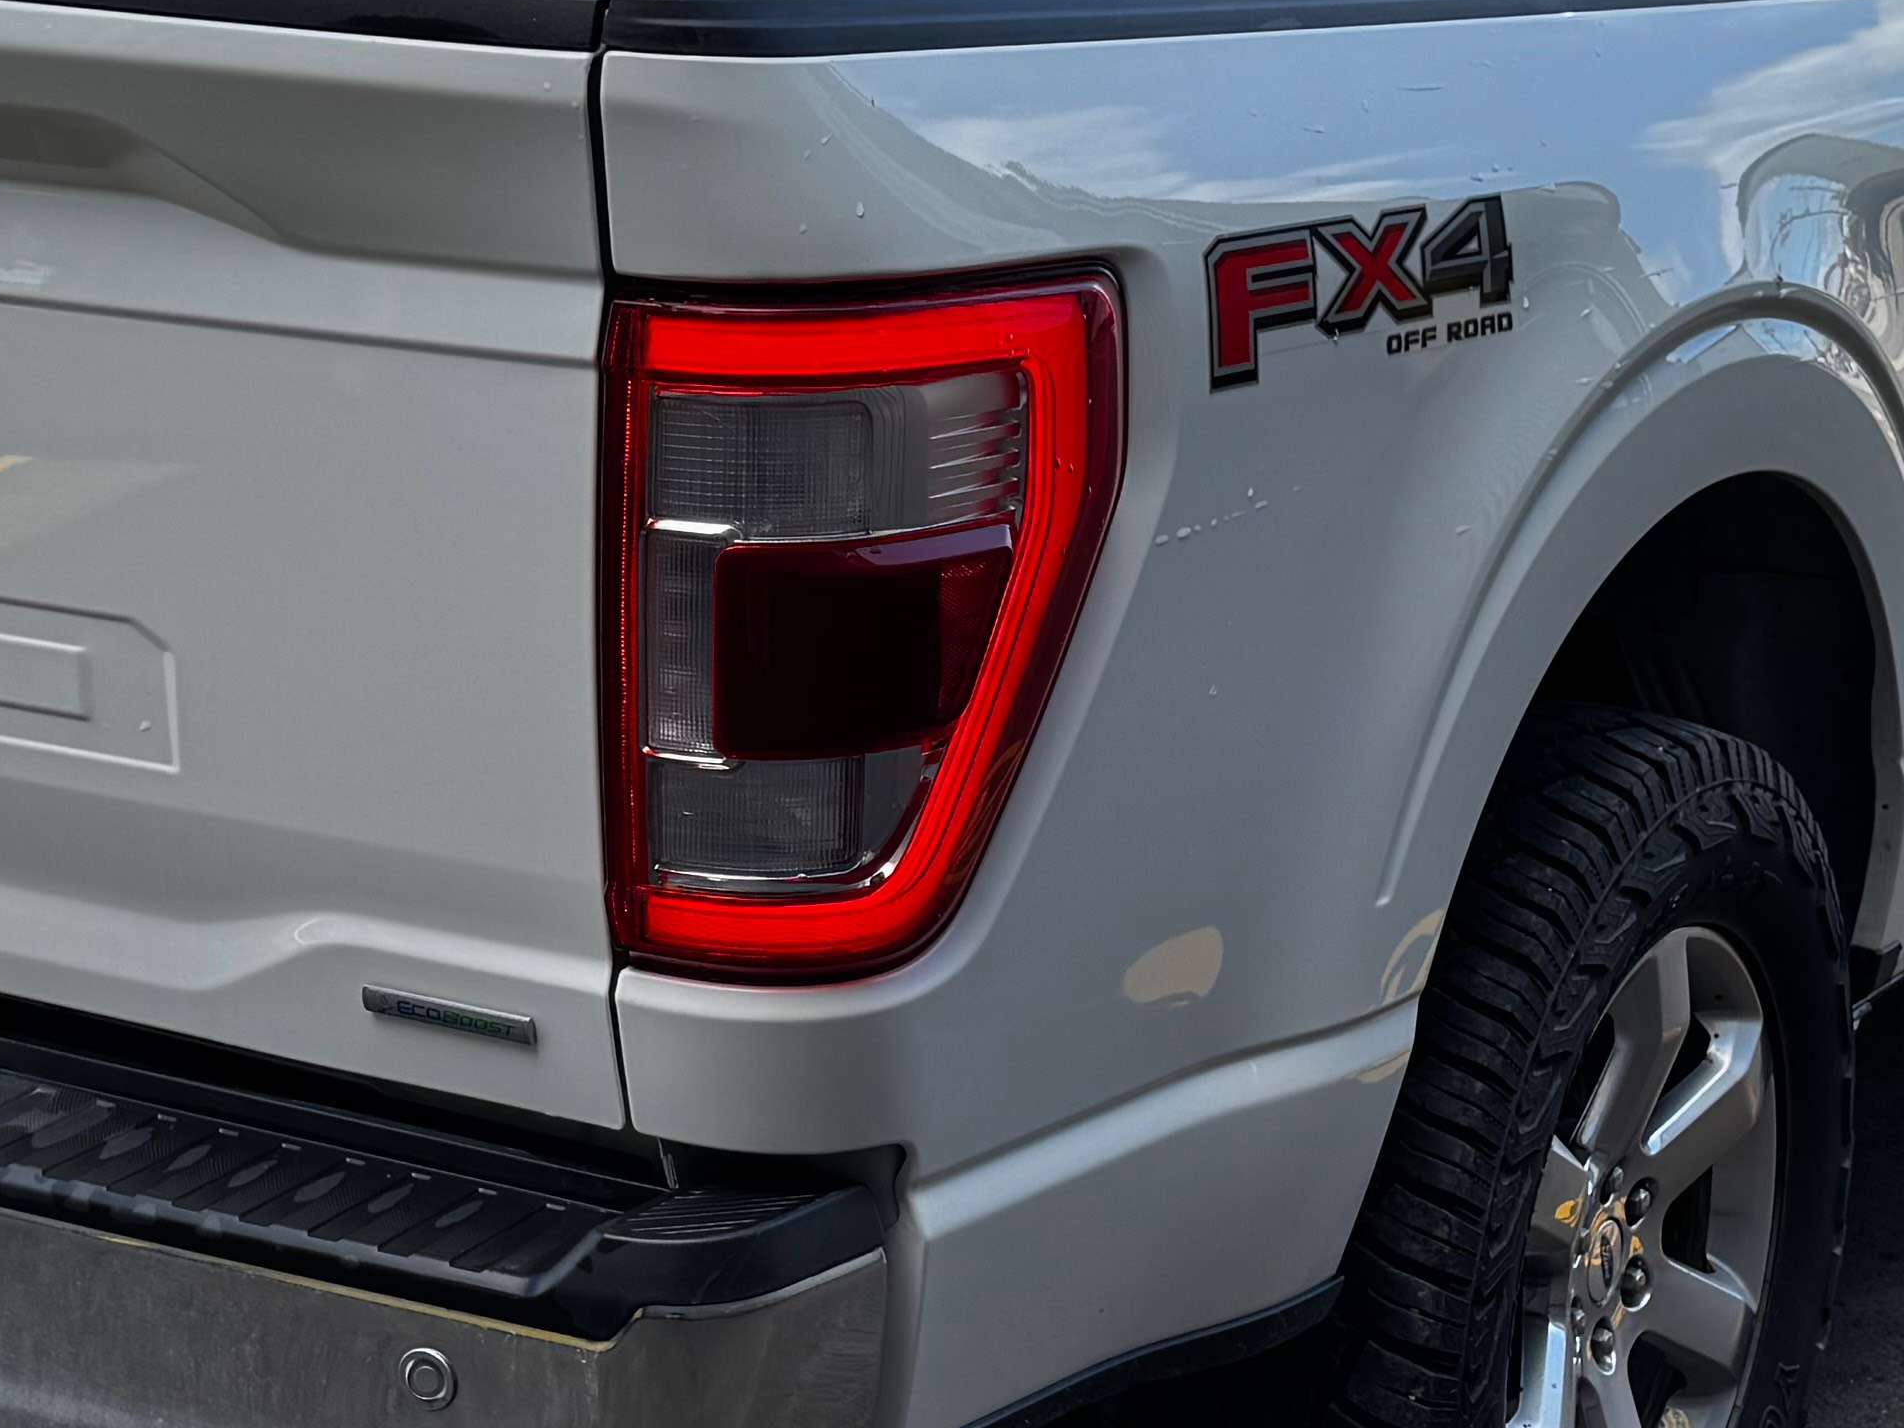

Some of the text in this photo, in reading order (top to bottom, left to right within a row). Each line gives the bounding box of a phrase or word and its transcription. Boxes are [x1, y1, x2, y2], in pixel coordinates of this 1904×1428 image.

[1202, 193, 1516, 394] FX4
[1385, 311, 1514, 356] OFF ROAD
[396, 1000, 517, 1037] ECOBOOST
